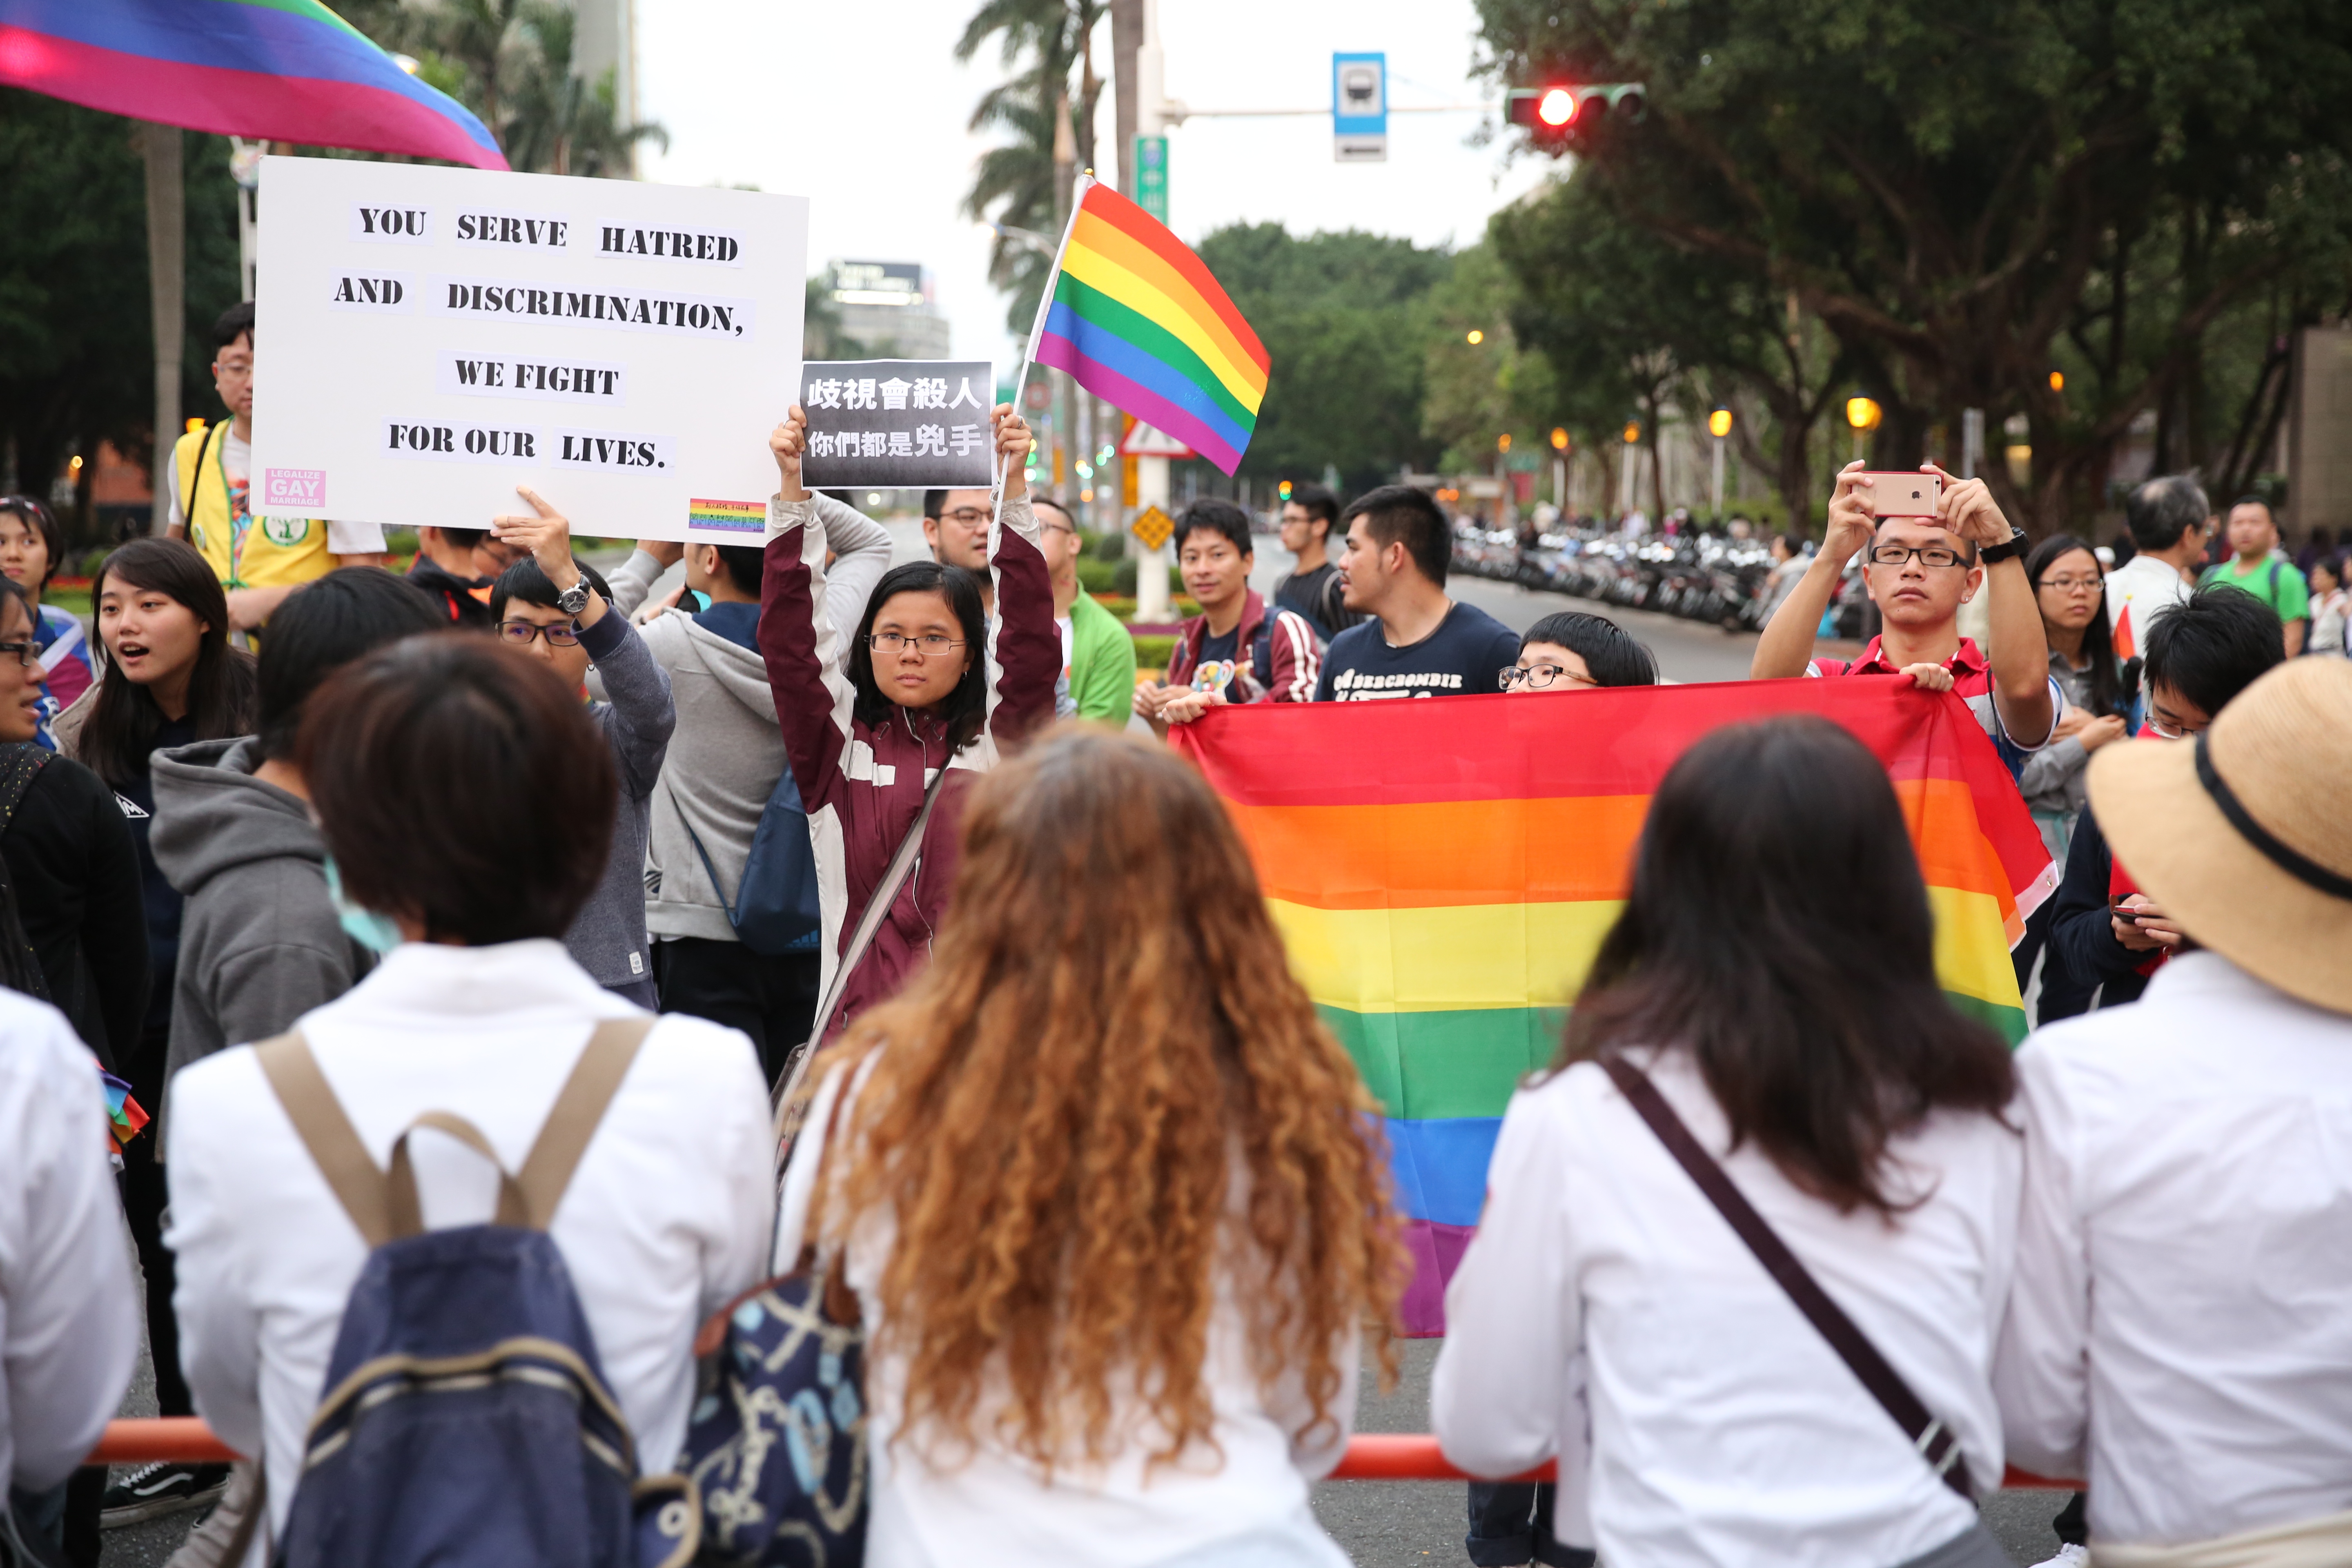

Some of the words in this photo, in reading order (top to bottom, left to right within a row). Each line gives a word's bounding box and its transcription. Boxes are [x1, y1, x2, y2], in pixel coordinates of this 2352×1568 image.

[359, 208, 426, 236] YOU
[457, 215, 568, 247] SERVE
[601, 227, 738, 262] HATRED
[334, 277, 403, 305] AND
[448, 284, 743, 337] DISCRIMINATION,
[455, 360, 504, 387] WE
[514, 364, 619, 395] FIGHT
[807, 376, 983, 410] 歧視會殺人
[389, 424, 454, 452] FOR
[465, 429, 536, 458] OUR
[561, 435, 666, 468] LIVES.
[808, 423, 983, 458] 你們都是兇手
[270, 479, 319, 497] GAY
[271, 470, 320, 479] LEGALIZE
[271, 497, 319, 506] MARRIAGE
[1333, 668, 1463, 691] ABERCROMBIE
